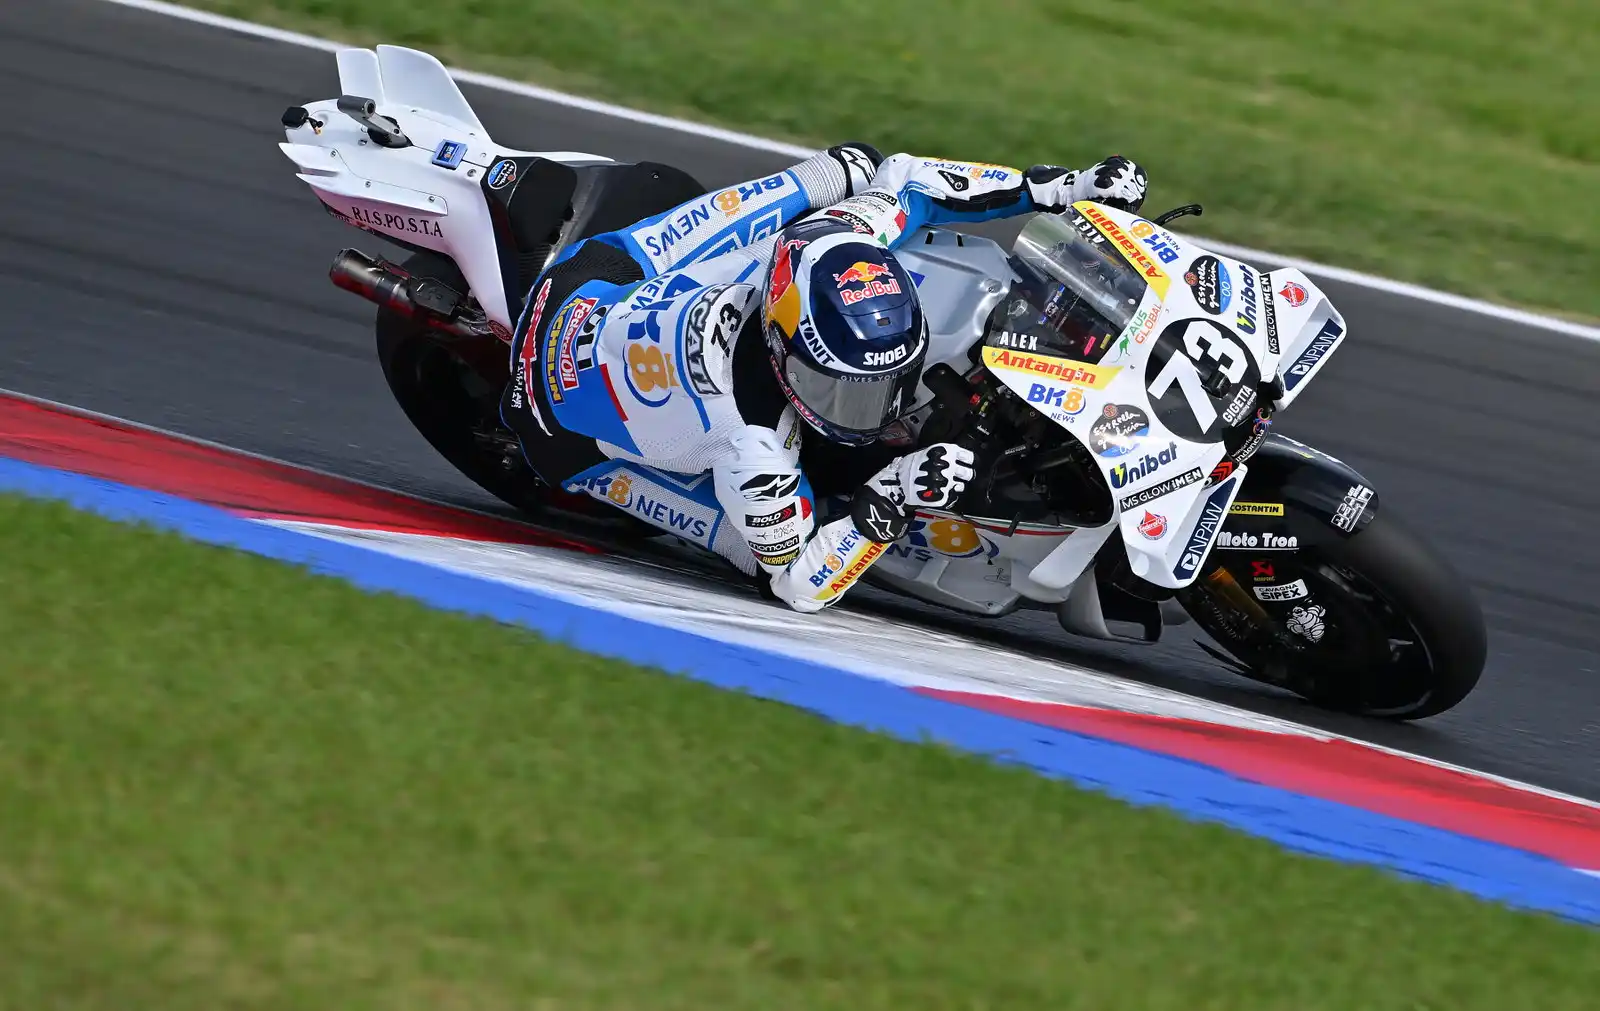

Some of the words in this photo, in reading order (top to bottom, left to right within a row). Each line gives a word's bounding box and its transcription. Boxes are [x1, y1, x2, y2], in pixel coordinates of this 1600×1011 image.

[645, 204, 710, 256] NEWS
[1072, 215, 1106, 244] ALEX
[1086, 207, 1163, 278] Antangin
[1130, 219, 1180, 264] BK8
[1161, 231, 1181, 251] NEWS
[840, 284, 873, 306] Red
[874, 278, 901, 297] Bull
[1236, 264, 1257, 335] Unibat
[1130, 310, 1148, 336] AUS
[1134, 303, 1162, 345] GLOBAL
[547, 298, 584, 401] MICHELIN
[863, 344, 906, 366] SHOEI
[1000, 331, 1038, 351] ALEX
[840, 375, 873, 383] GIVES
[878, 374, 898, 382] YOU
[994, 351, 1097, 384] Antangin
[1147, 320, 1249, 435] 73
[1027, 383, 1084, 413] BK8
[1222, 385, 1253, 423] GIGETTA
[1050, 412, 1075, 424] NEWS
[1110, 441, 1178, 489] Unibat
[1121, 496, 1139, 509] MS
[1139, 481, 1171, 502] GLOW
[636, 494, 708, 538] NEWS
[753, 512, 781, 523] BOLD
[750, 537, 799, 551] momoven
[1217, 531, 1258, 547] Moto
[1262, 532, 1298, 547] Tron
[1260, 588, 1301, 600] SIPEX
